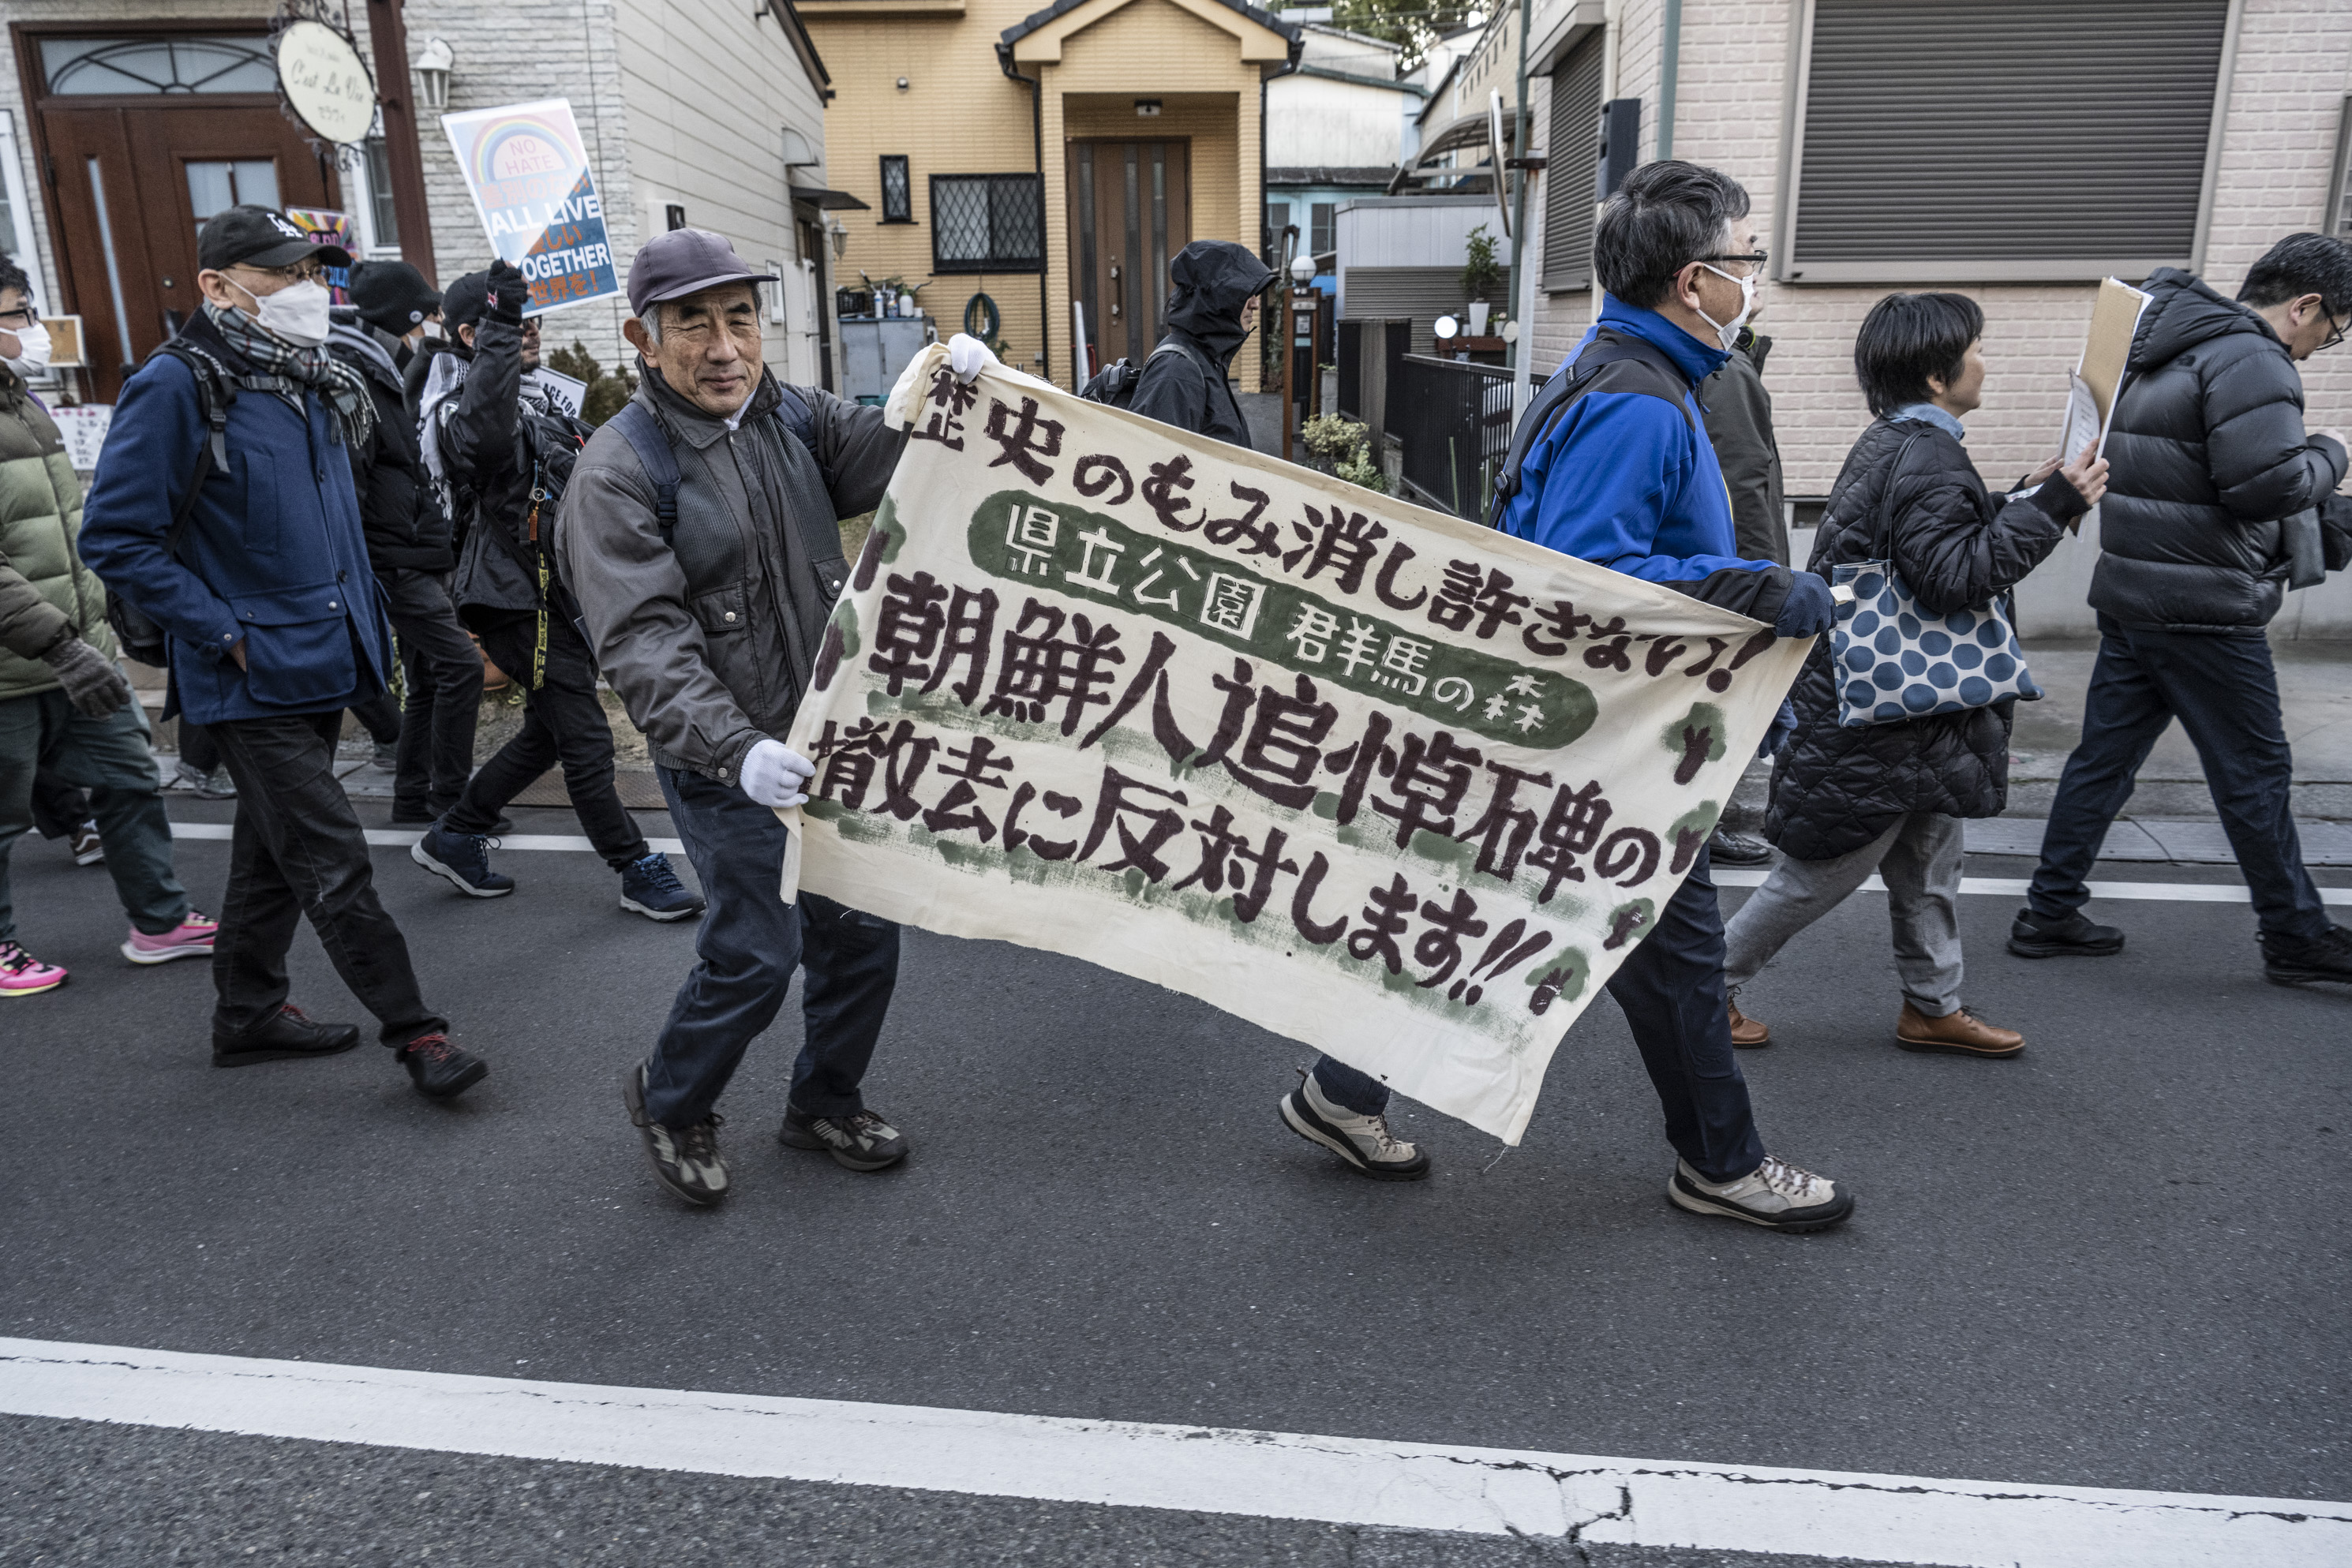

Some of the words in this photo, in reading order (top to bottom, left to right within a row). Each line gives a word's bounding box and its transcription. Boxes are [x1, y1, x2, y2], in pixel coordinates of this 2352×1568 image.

[508, 139, 537, 156] NO
[504, 155, 554, 175] HATE
[478, 174, 590, 209] 差別のない
[490, 207, 543, 237] ALL
[545, 194, 602, 226] LIVE
[560, 395, 577, 418] FOR
[868, 571, 1661, 904] 朝鮮人追悼碑の
